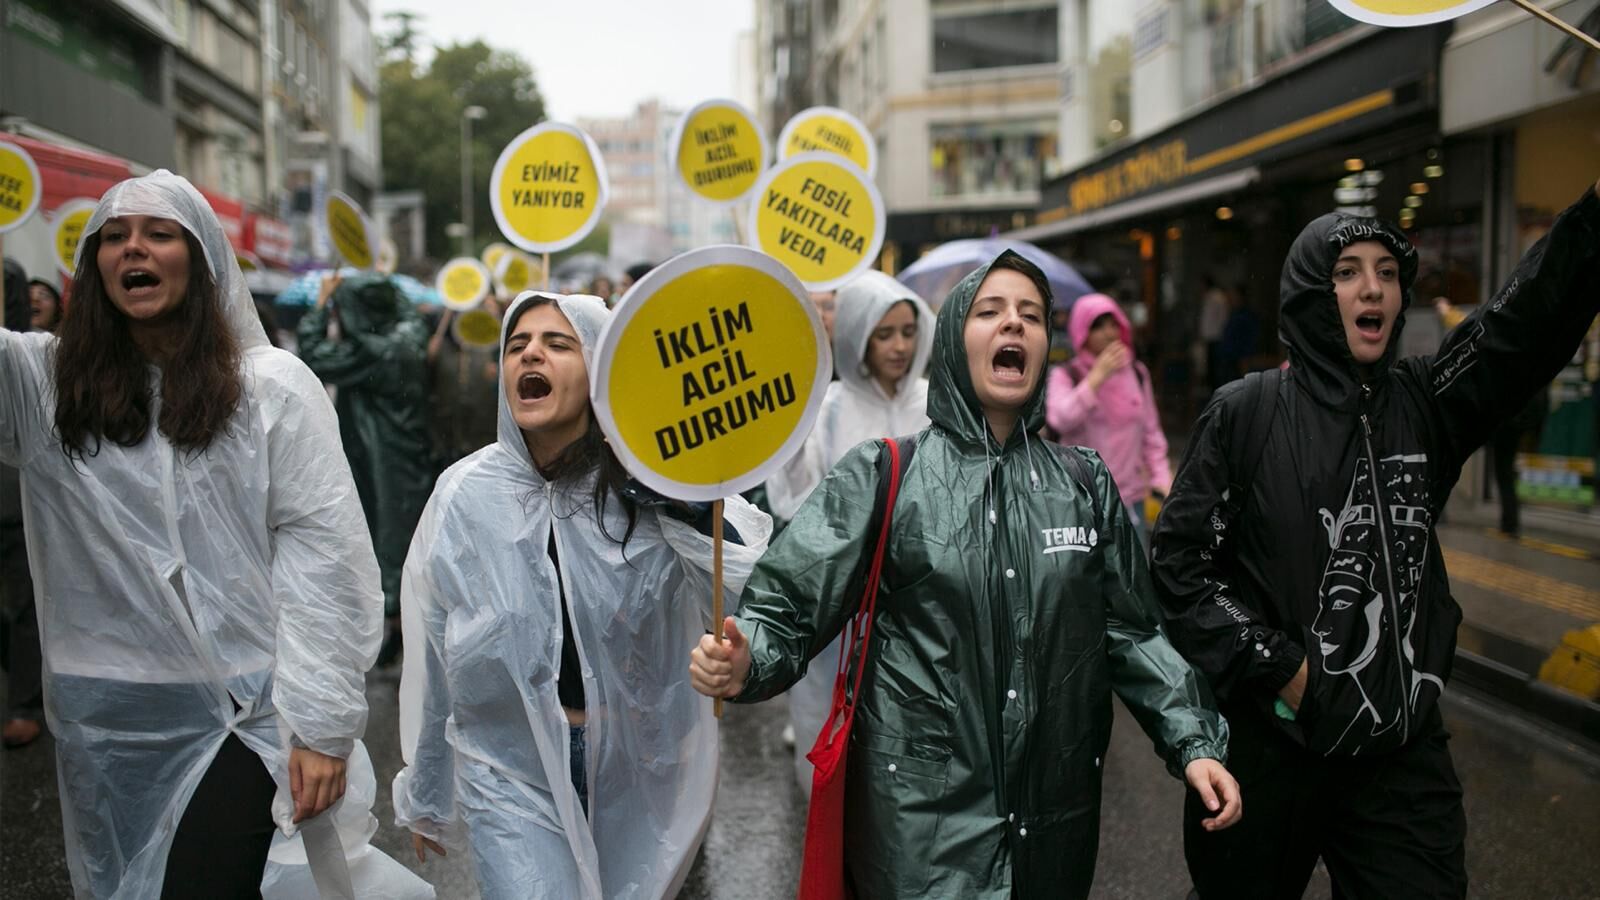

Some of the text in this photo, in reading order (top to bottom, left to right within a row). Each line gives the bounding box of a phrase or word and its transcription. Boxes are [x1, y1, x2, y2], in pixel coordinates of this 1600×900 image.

[522, 160, 579, 183] EVİMİZ
[512, 188, 584, 209] YANIYOR
[801, 177, 852, 217] FOSİL
[766, 189, 866, 255] YAKITLARA
[778, 226, 827, 266] VEDA
[653, 301, 754, 369] İKLİM
[682, 348, 756, 407] ACİL
[654, 372, 797, 461] DURUMU
[1041, 526, 1088, 546] TEMA
